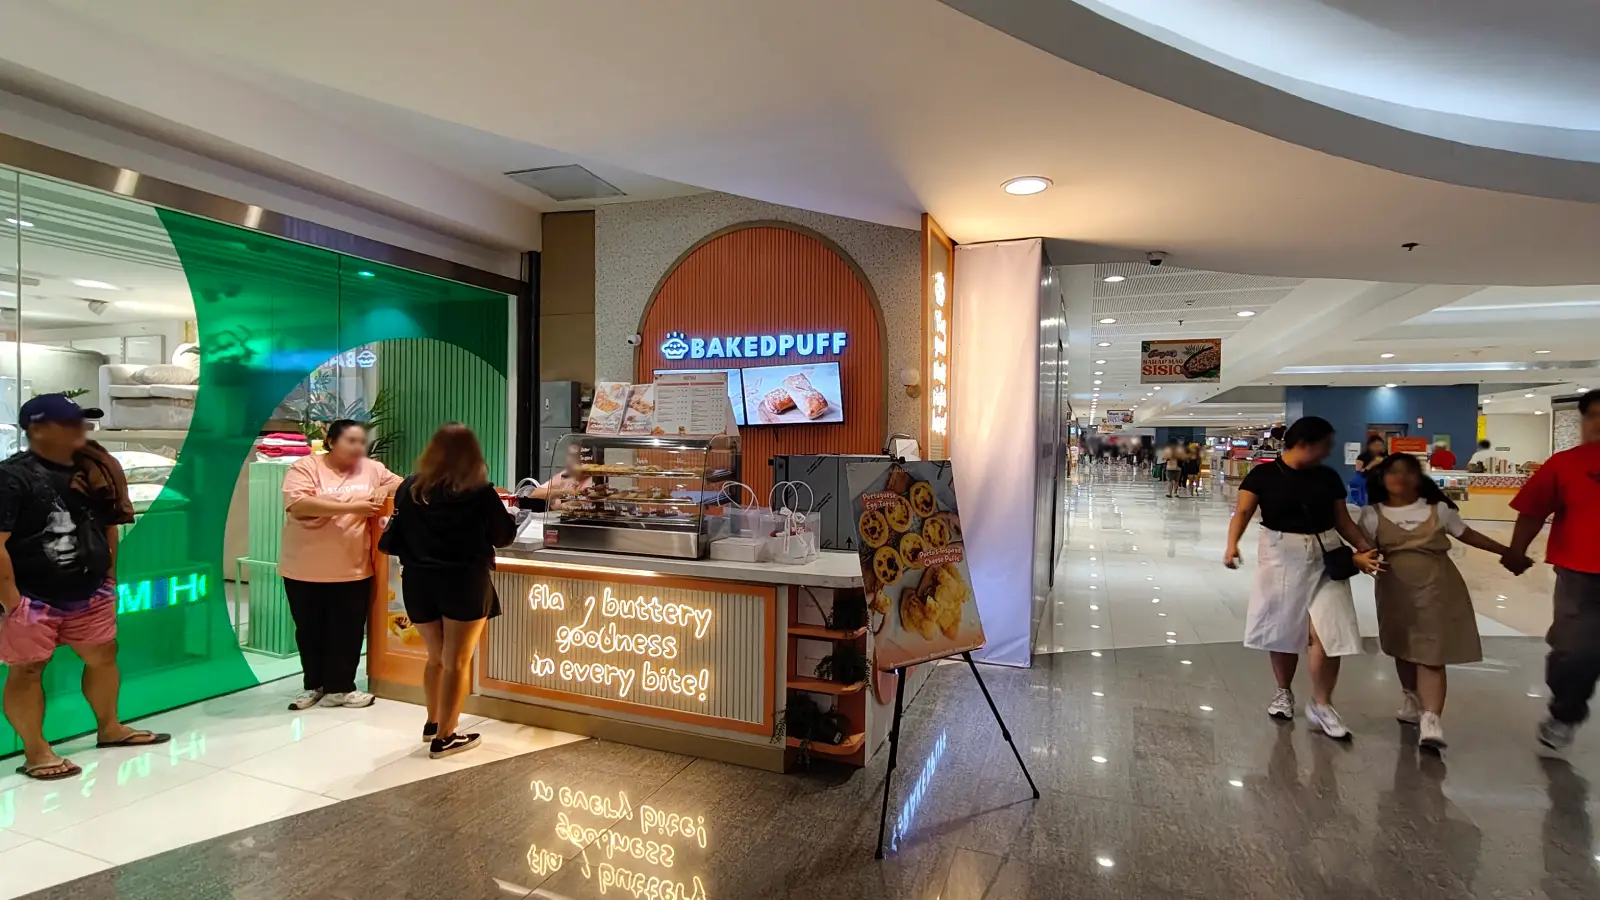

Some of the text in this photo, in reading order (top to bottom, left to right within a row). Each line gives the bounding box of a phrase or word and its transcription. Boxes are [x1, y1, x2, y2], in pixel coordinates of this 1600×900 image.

[691, 332, 847, 359] BAKEDPUFF
[866, 502, 877, 511] Egg
[602, 587, 712, 639] buttery
[556, 623, 677, 658] goodness
[531, 653, 709, 702] in every bite!
